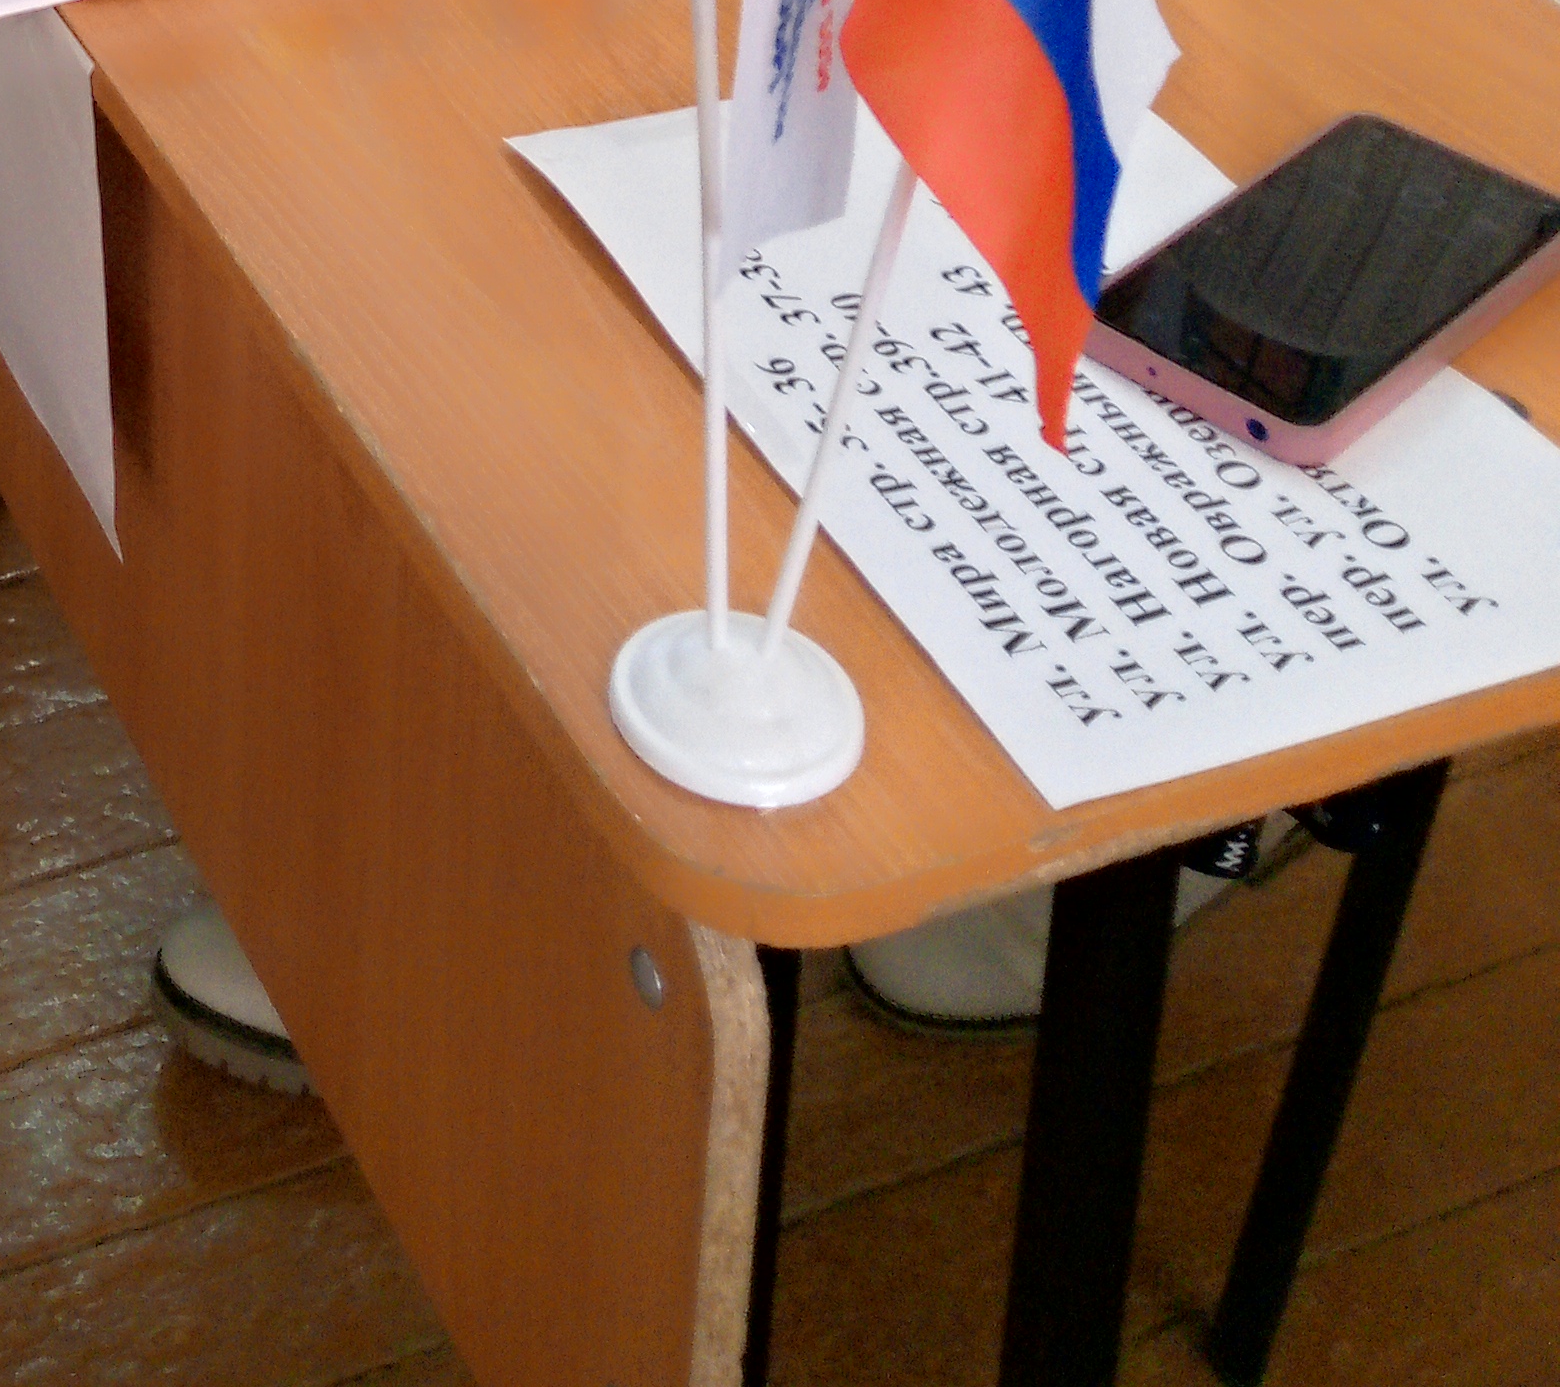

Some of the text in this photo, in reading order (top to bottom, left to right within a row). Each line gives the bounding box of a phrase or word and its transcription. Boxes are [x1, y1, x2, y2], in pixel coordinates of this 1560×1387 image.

[940, 265, 993, 297] 43
[753, 357, 816, 395] 36
[820, 333, 882, 397] ср.
[930, 322, 1029, 404] 41-42
[830, 293, 1251, 693] ул. Нагорная стр.39-0
[869, 462, 937, 533] стр.
[874, 405, 1111, 644] Молодежная
[1270, 493, 1346, 549] ул.
[1100, 484, 1236, 608] Новая
[1295, 462, 1499, 616] ул. Октя
[932, 541, 1047, 658] Мира
[1279, 572, 1366, 653] пер.
[1341, 554, 1427, 634] пер.
[1237, 609, 1315, 672] ул.
[1045, 663, 1123, 727] ул.
[1110, 648, 1187, 711] ул.
